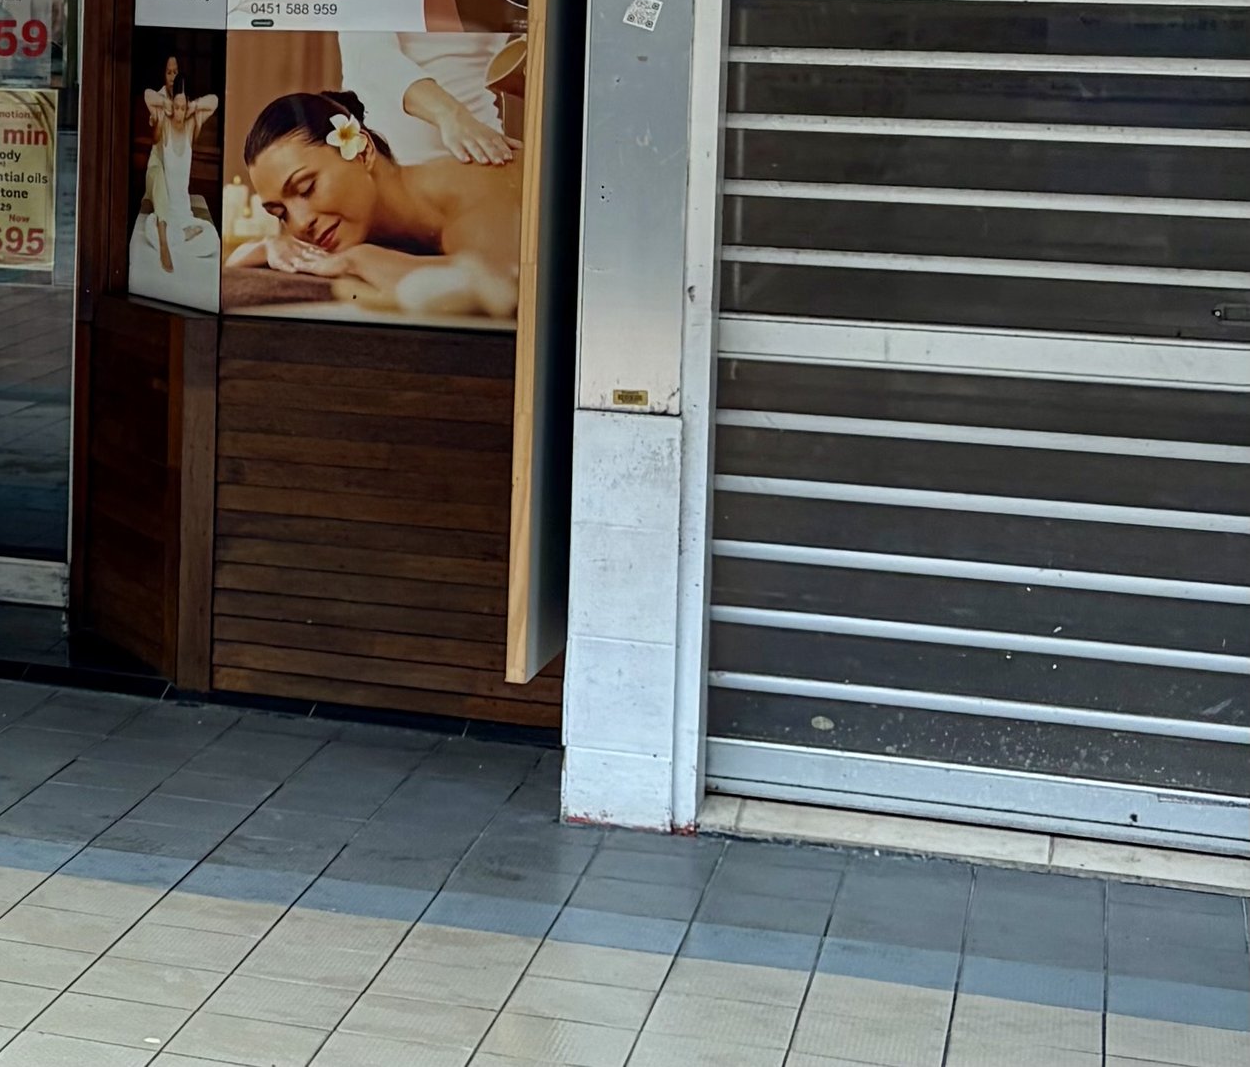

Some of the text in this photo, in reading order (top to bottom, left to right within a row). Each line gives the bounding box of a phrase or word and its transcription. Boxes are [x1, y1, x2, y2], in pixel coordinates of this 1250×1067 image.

[251, 2, 338, 15] 0451 588 959
[3, 124, 49, 146] min
[27, 172, 49, 184] oils
[9, 214, 30, 223] Now
